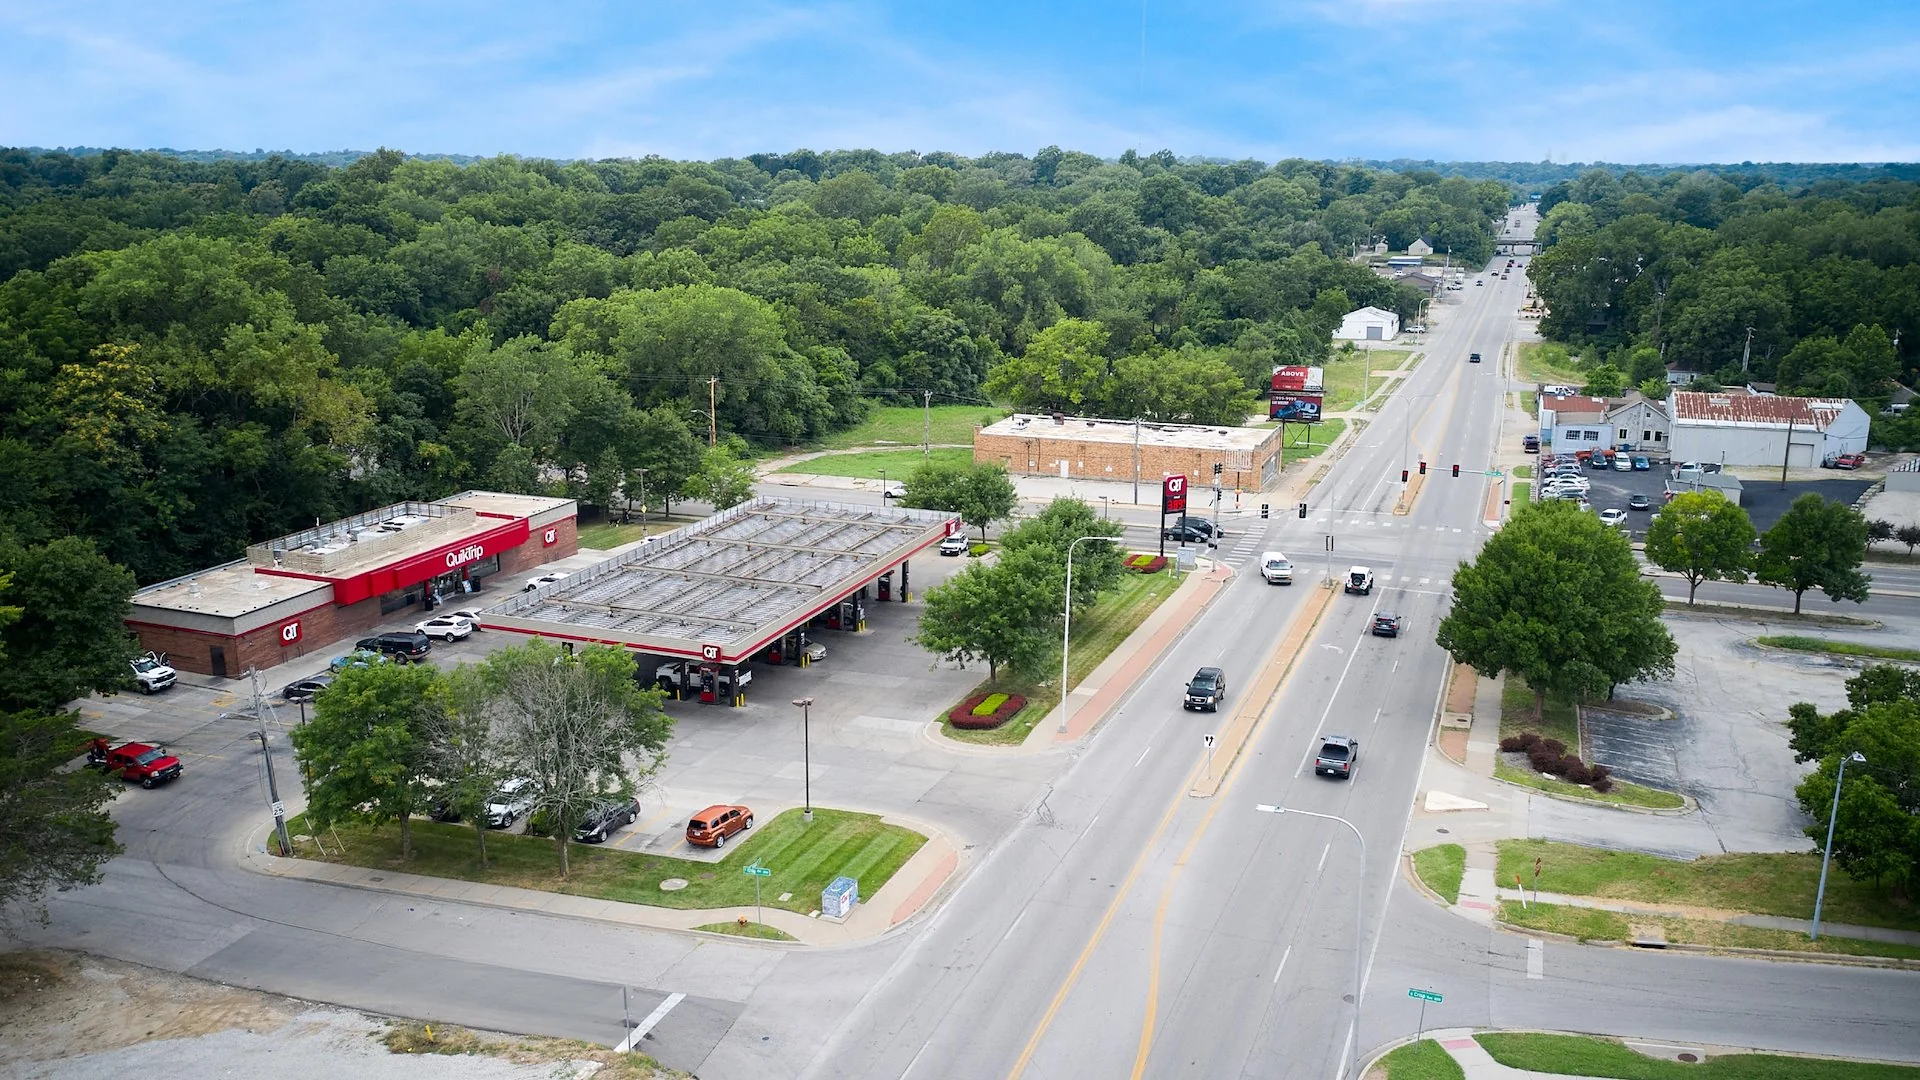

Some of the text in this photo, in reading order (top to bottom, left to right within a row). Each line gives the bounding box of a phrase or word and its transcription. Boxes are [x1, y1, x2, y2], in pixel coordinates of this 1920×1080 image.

[1168, 478, 1183, 492] QT
[545, 529, 556, 543] QT
[446, 545, 484, 567] QuikTrip
[282, 623, 298, 640] QT
[703, 646, 718, 659] QT
